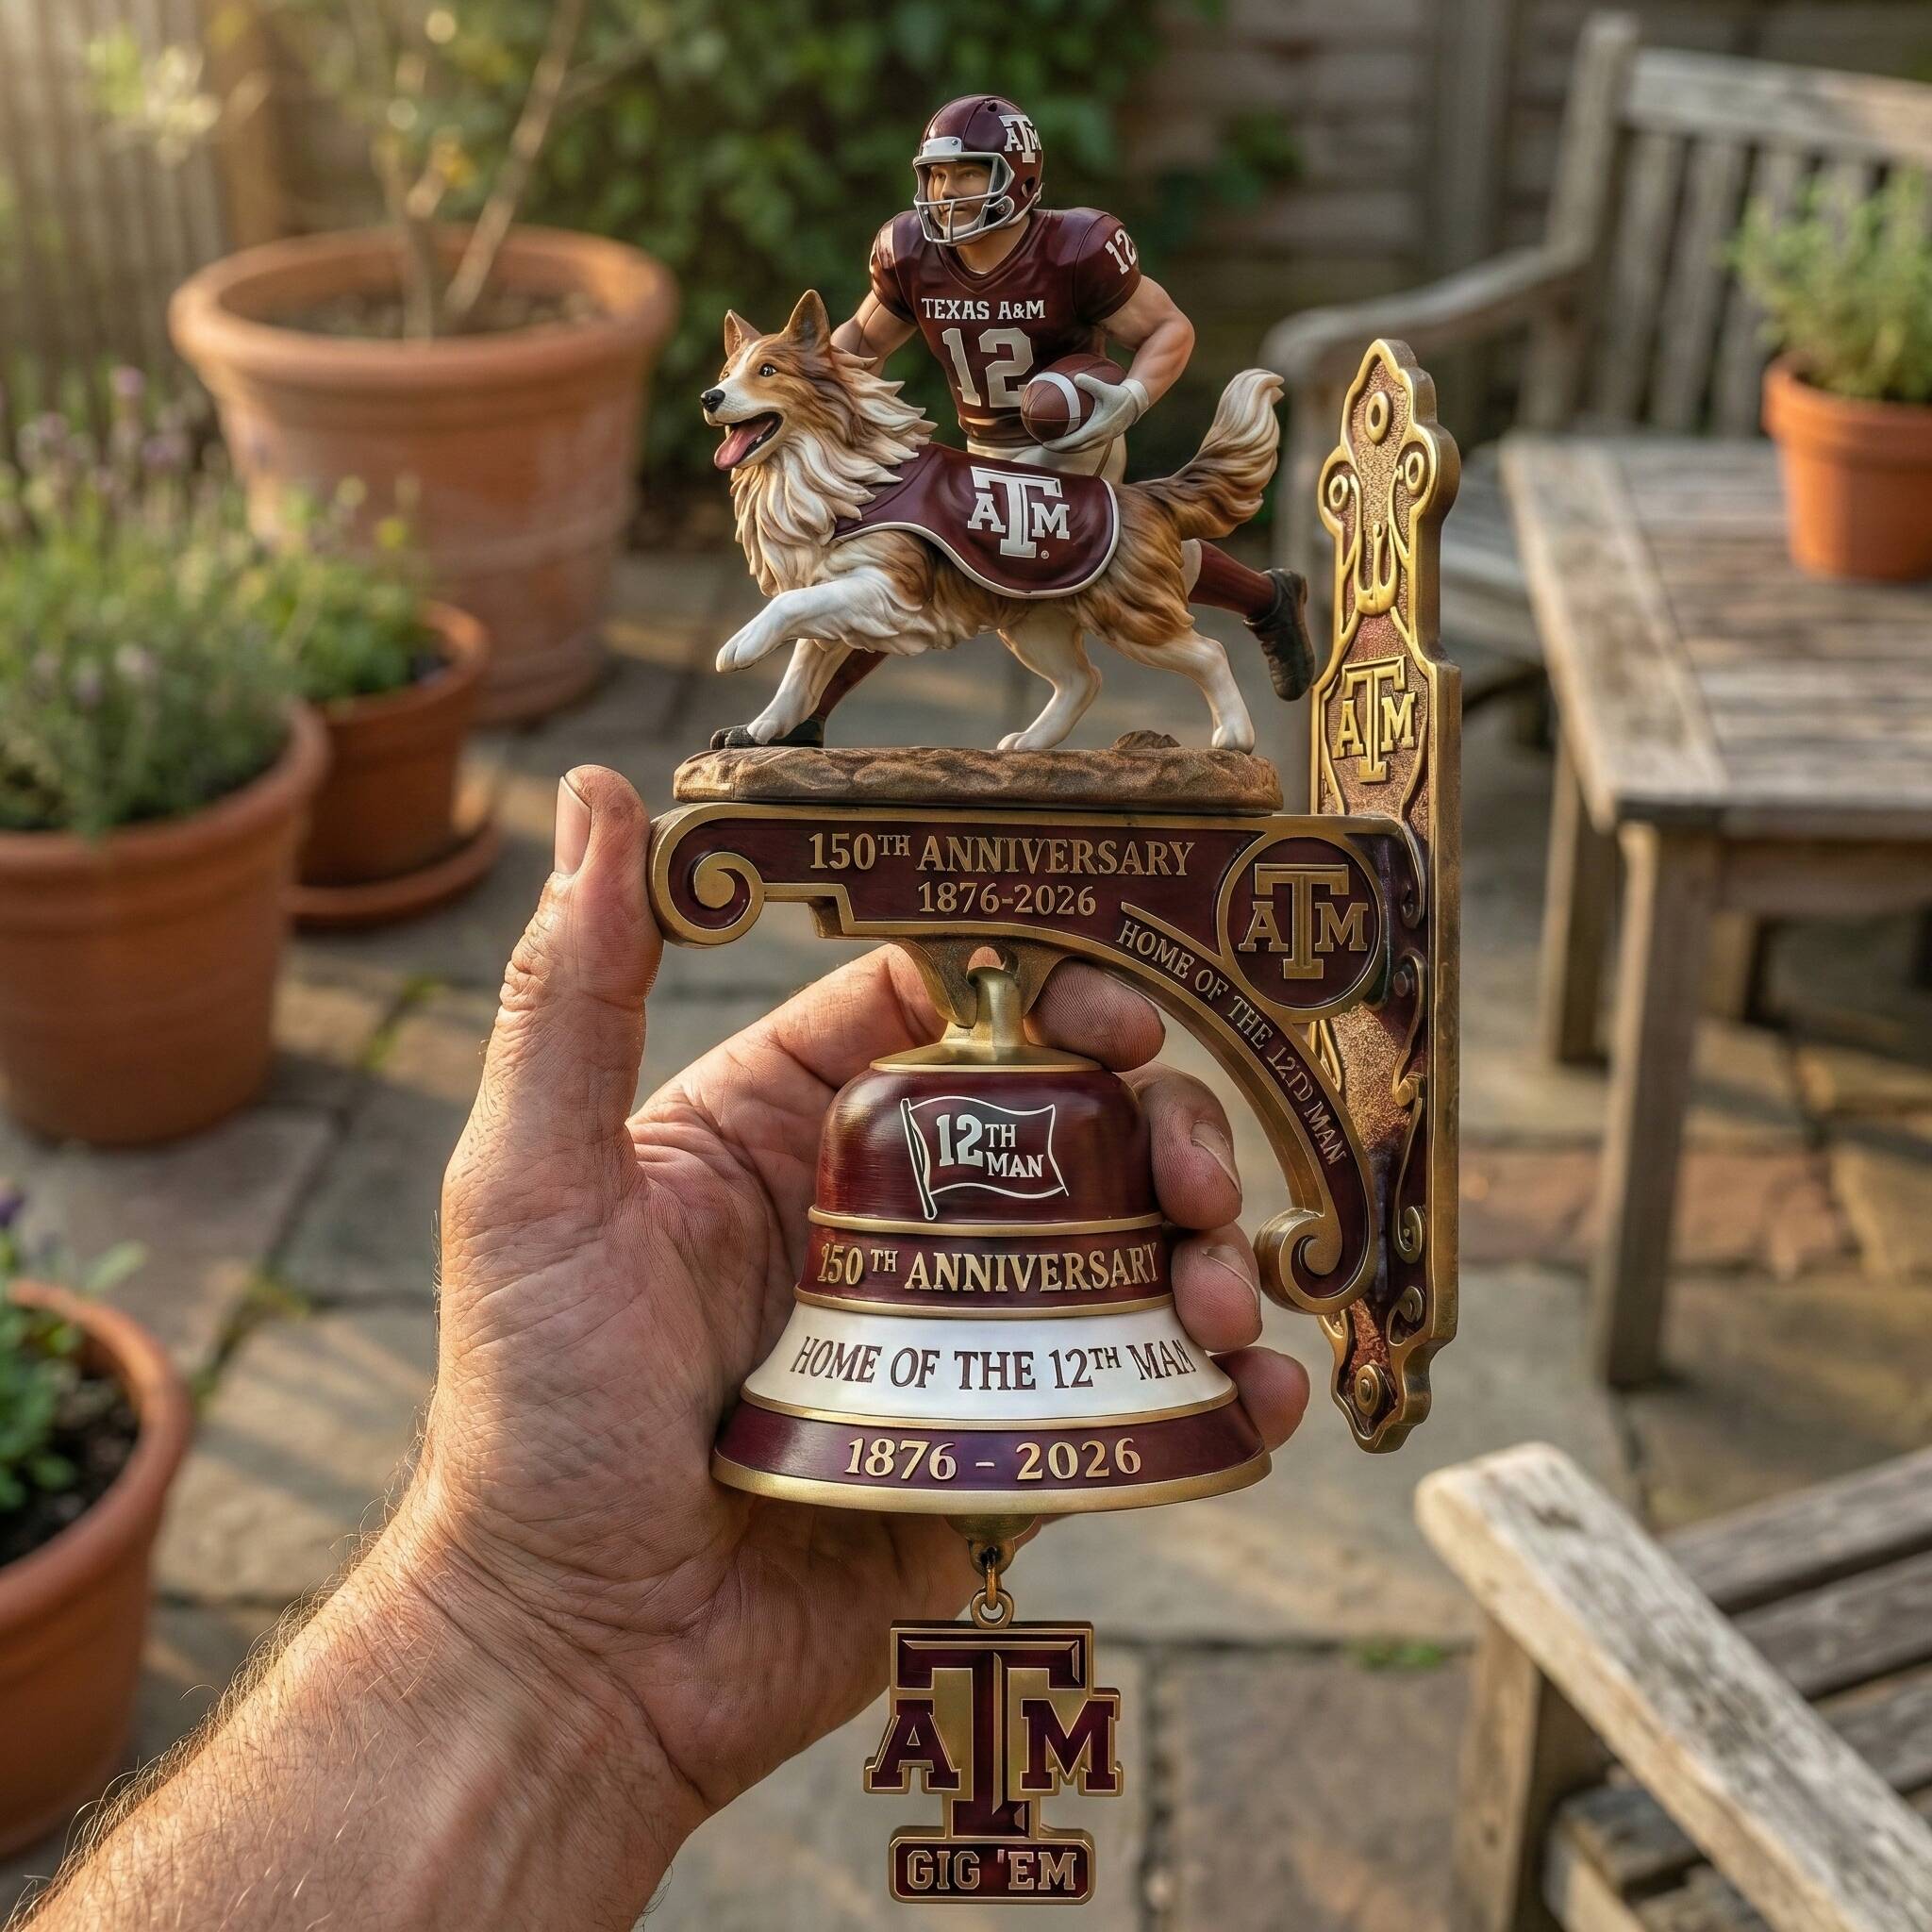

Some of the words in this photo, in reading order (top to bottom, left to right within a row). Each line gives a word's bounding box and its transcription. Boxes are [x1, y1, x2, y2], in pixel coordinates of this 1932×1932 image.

[1105, 228, 1138, 275] 12
[921, 297, 990, 320] TEXAS
[997, 299, 1046, 319] A&M
[942, 327, 1034, 408] 12
[808, 832, 911, 871] 150TH
[915, 835, 1195, 876] ANNIVERSARY
[917, 881, 1097, 916] 1876-2026
[1116, 920, 1195, 980] HOME
[1193, 969, 1230, 1001] OF
[1225, 995, 1274, 1050] THE
[1304, 1100, 1347, 1166] MAN
[987, 1151, 1044, 1178] MAN
[904, 1241, 1160, 1292] ANNIVERSARY
[789, 1336, 882, 1384] HOME
[890, 1348, 941, 1389] OF
[953, 1351, 1037, 1391] THE
[1047, 1346, 1123, 1390] 12TH
[1125, 1339, 1196, 1381] MAN
[843, 1437, 958, 1482] 1876
[1015, 1437, 1142, 1481] 2026
[907, 1850, 980, 1890] GIG
[996, 1848, 1077, 1890] 'EM
